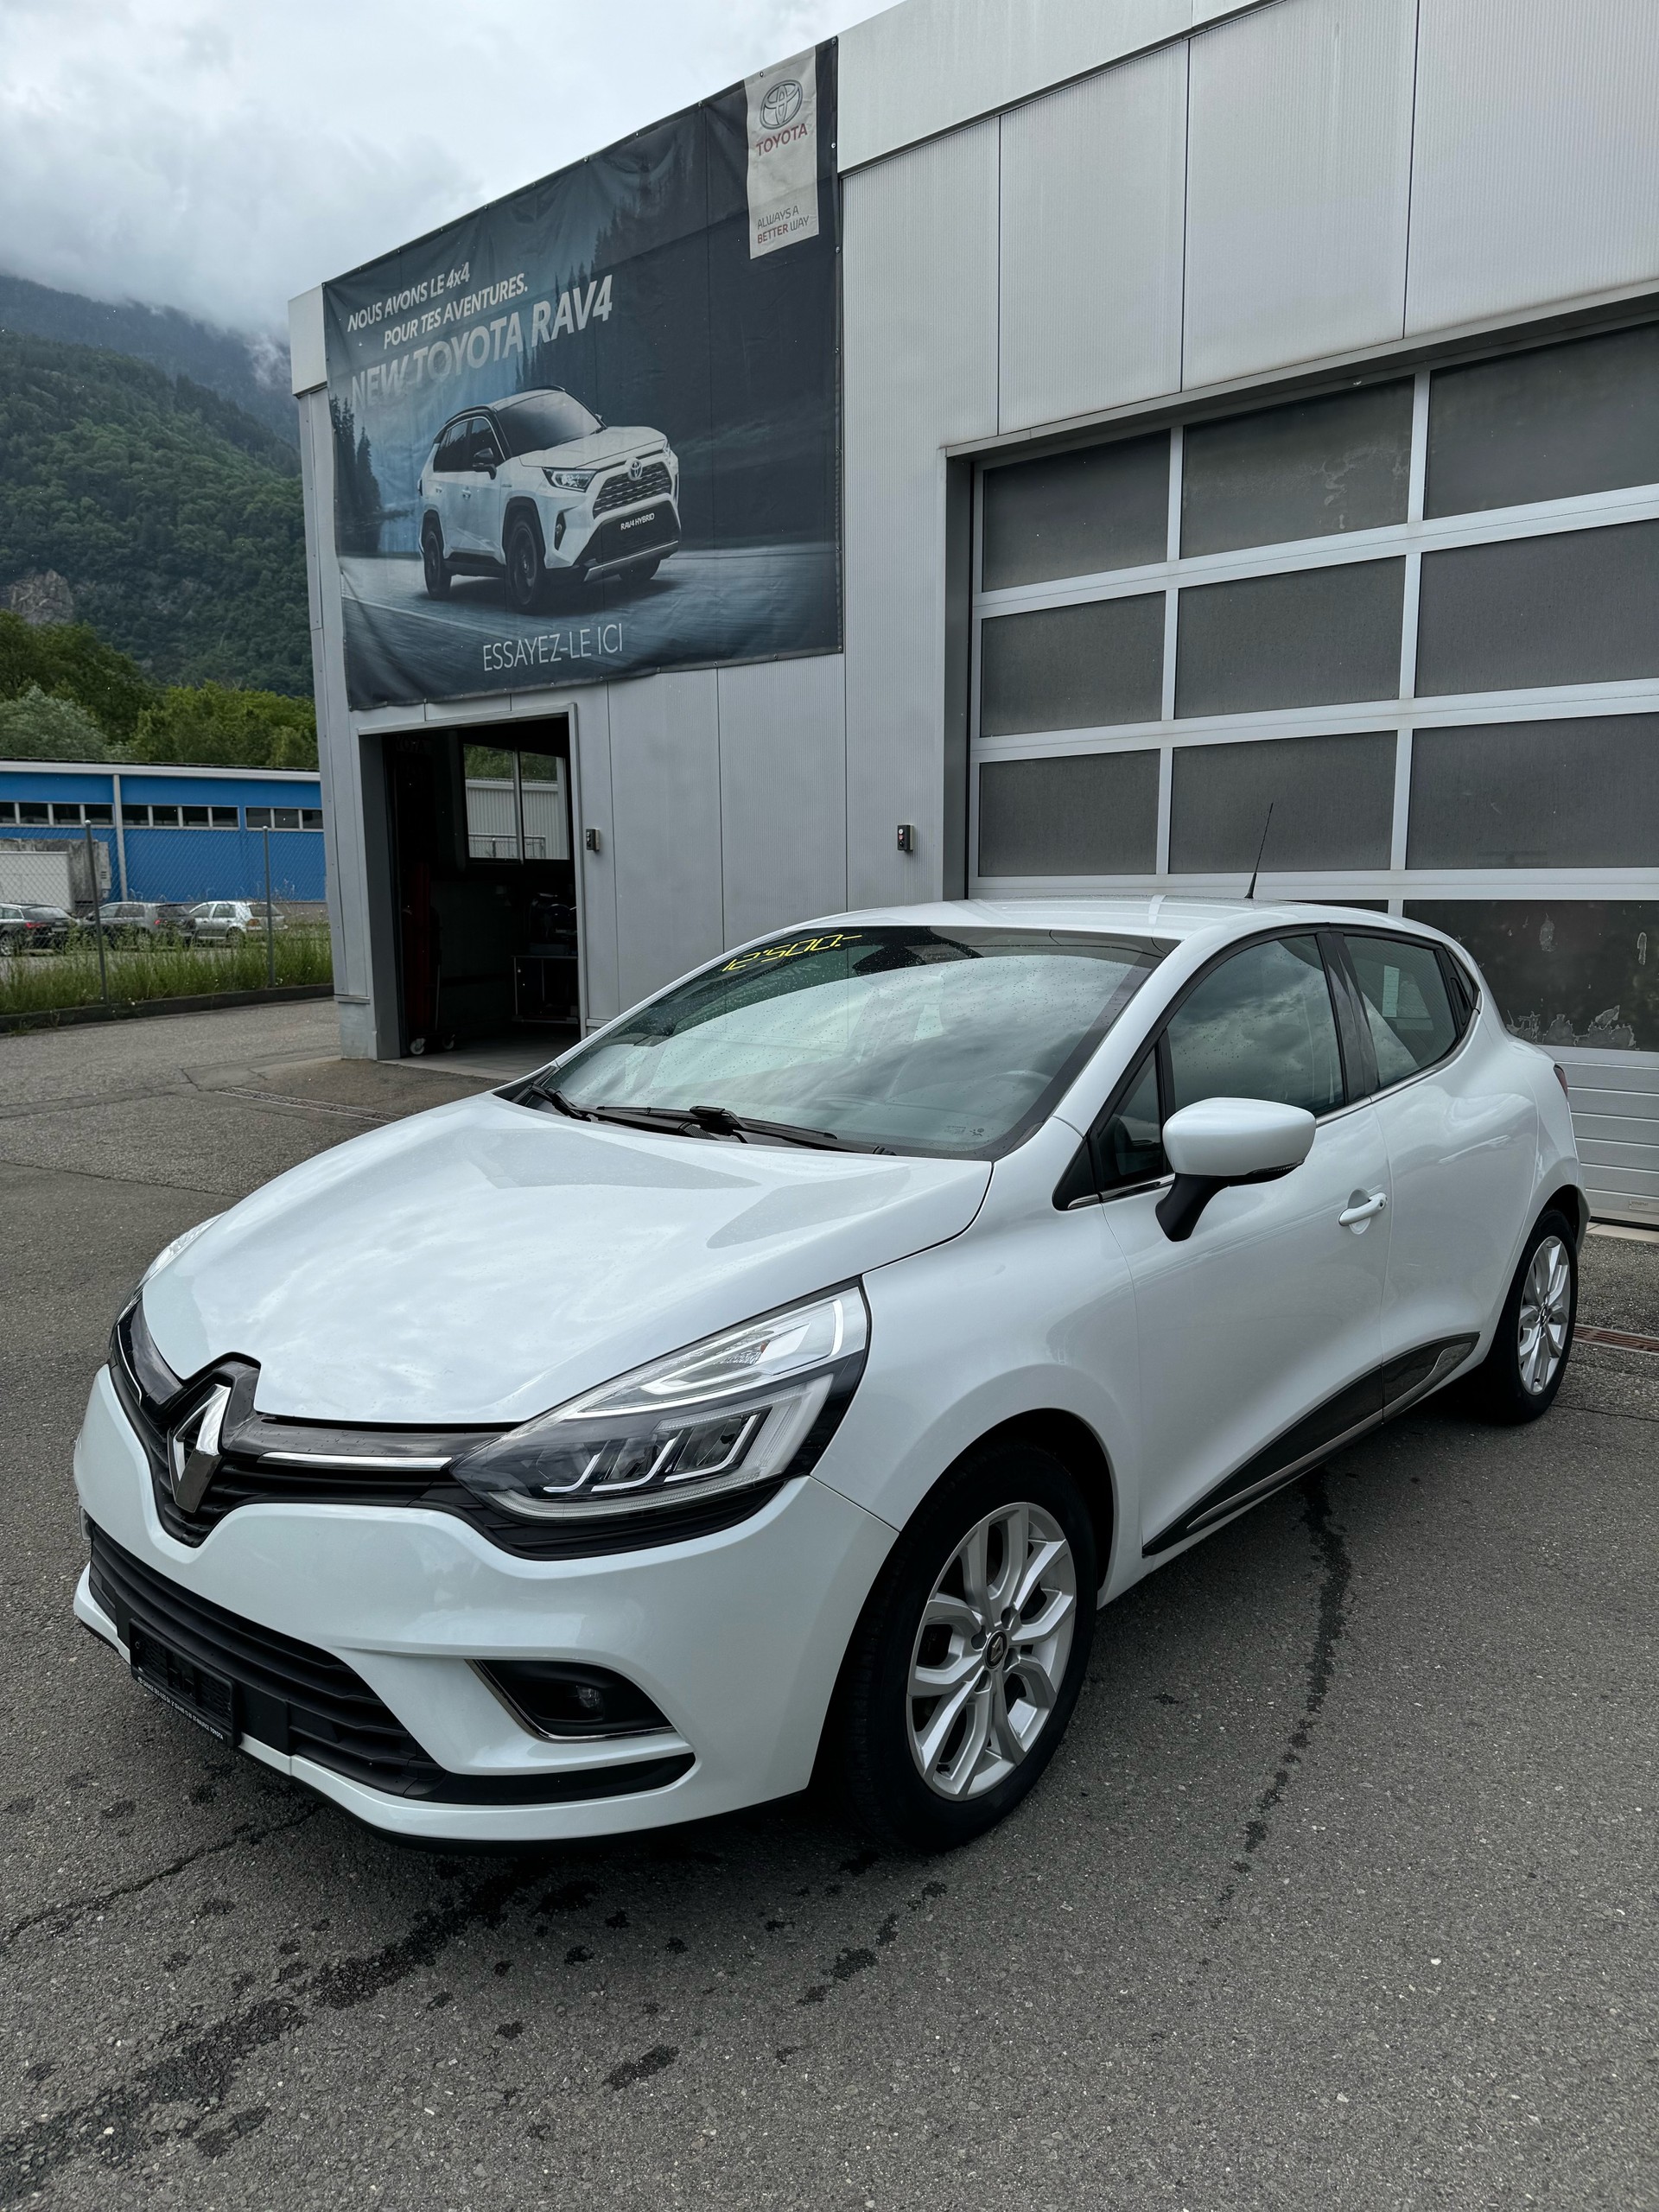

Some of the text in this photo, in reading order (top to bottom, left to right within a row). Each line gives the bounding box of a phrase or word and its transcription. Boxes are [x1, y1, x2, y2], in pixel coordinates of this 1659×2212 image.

[756, 123, 808, 156] TOYOTA
[757, 205, 800, 230] ALWAYS A
[757, 215, 810, 244] BETTER WAY
[347, 261, 471, 333] NOUS AVONS LE 4x4
[384, 272, 528, 350] POUR TES AVENTURES.
[352, 274, 613, 410] NEW TOYOTA RAV4
[620, 512, 655, 531] RAV4 HYBRID
[483, 622, 623, 671] ESSAYEZ-LE ICI
